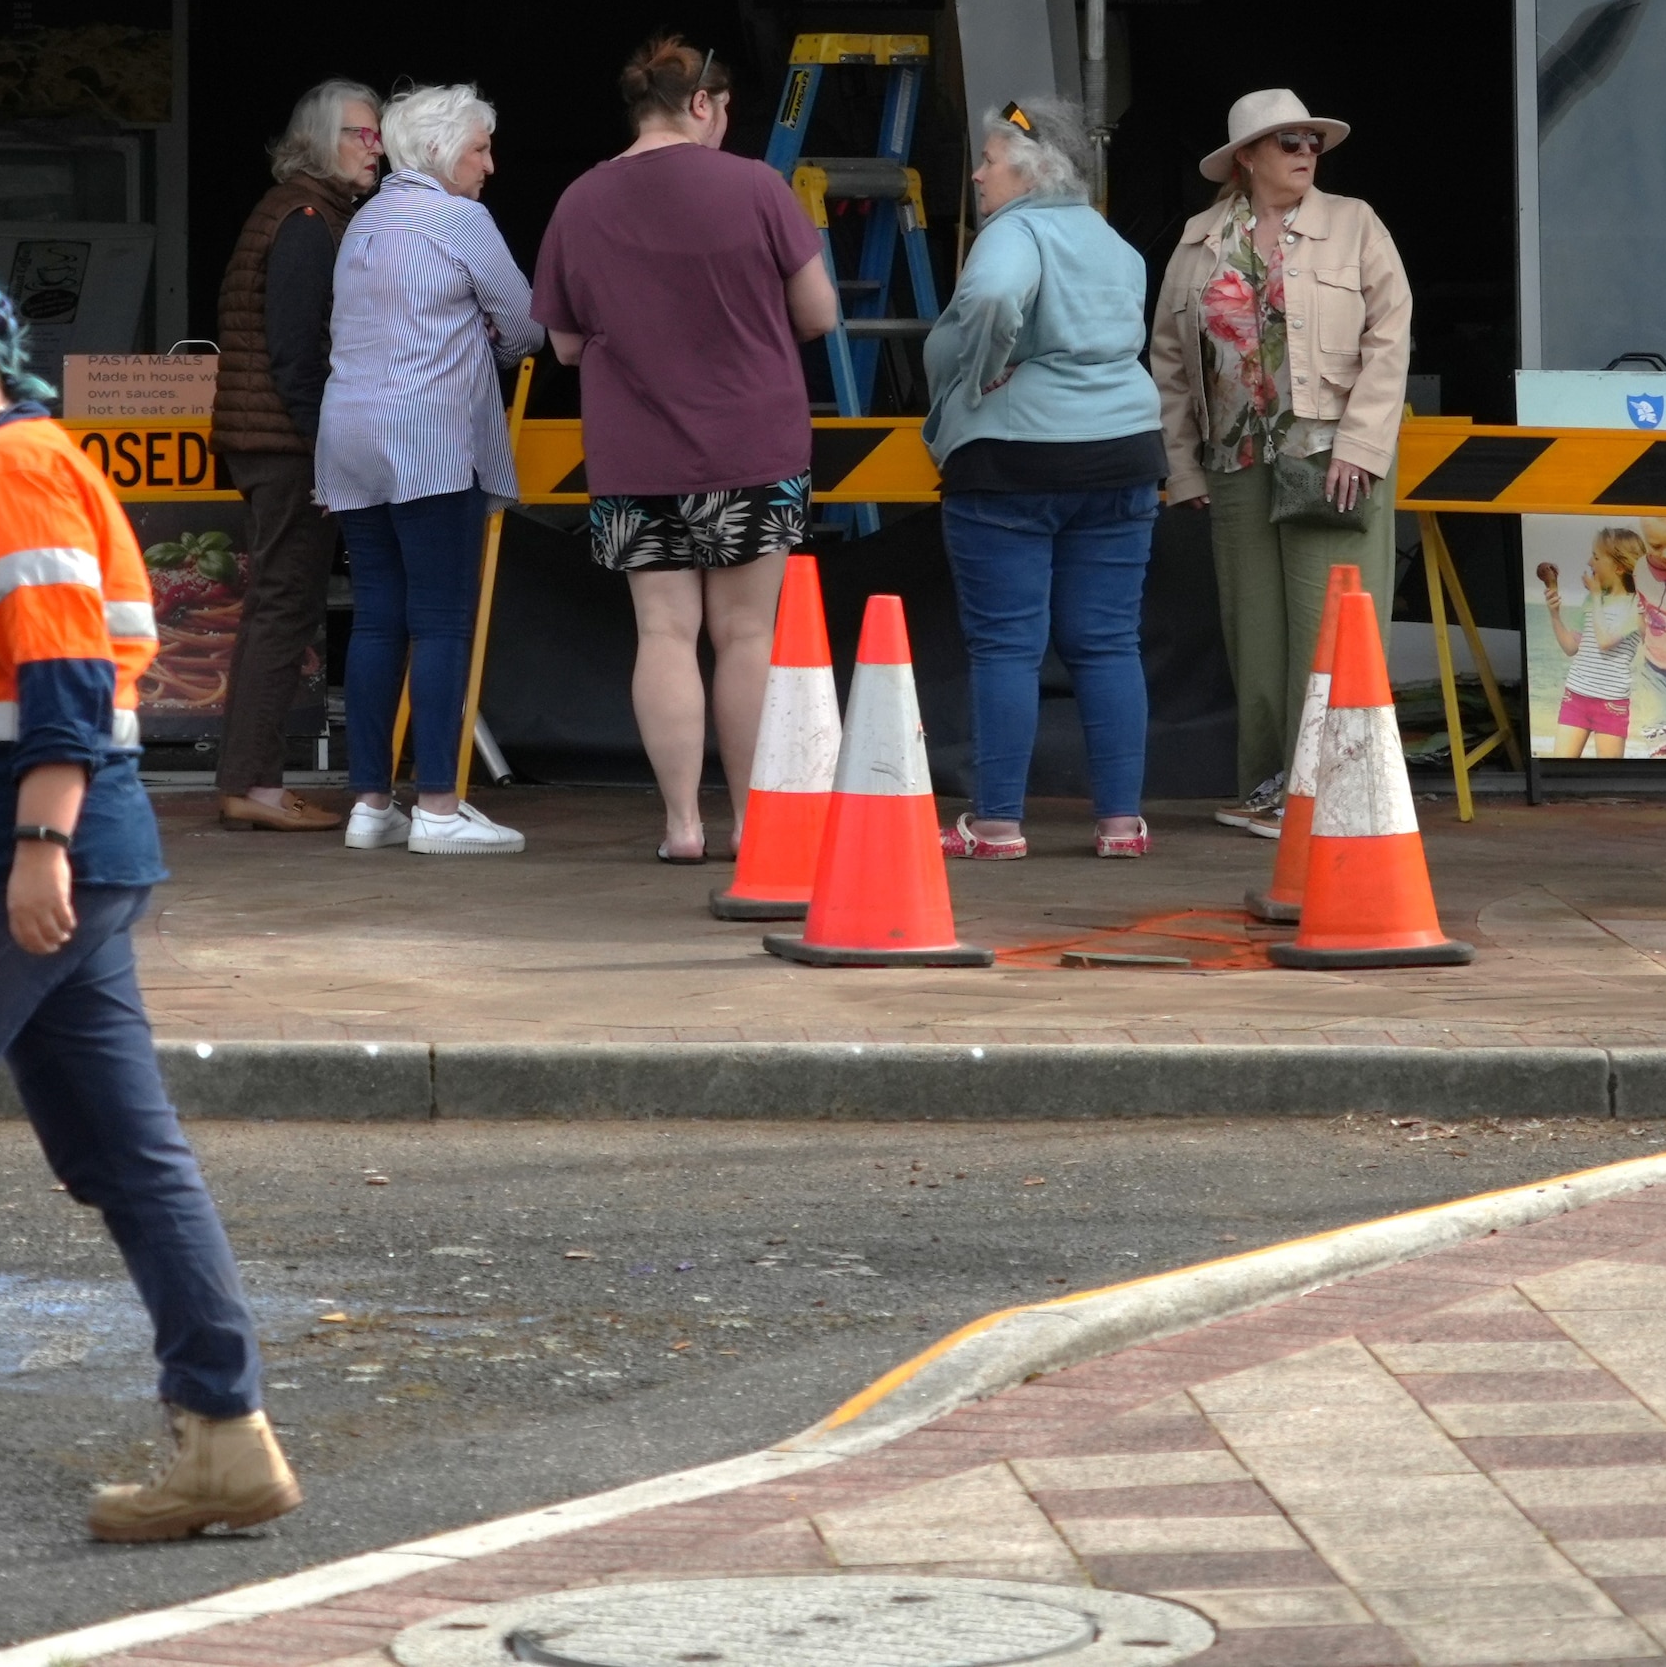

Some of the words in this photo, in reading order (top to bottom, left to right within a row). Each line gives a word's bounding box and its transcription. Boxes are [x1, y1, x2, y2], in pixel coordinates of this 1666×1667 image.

[790, 70, 811, 129] LEANSAFE
[87, 355, 143, 366] PASTA
[148, 355, 203, 366] MEALS
[87, 371, 128, 382] Made
[132, 371, 145, 382] in
[149, 371, 195, 382] house
[87, 390, 120, 399] own
[125, 389, 179, 399] sauces.
[87, 404, 113, 415] hot
[120, 405, 136, 415] to
[141, 405, 167, 415] eat
[170, 406, 185, 415] or
[191, 404, 205, 415] in
[79, 430, 208, 488] OSED
